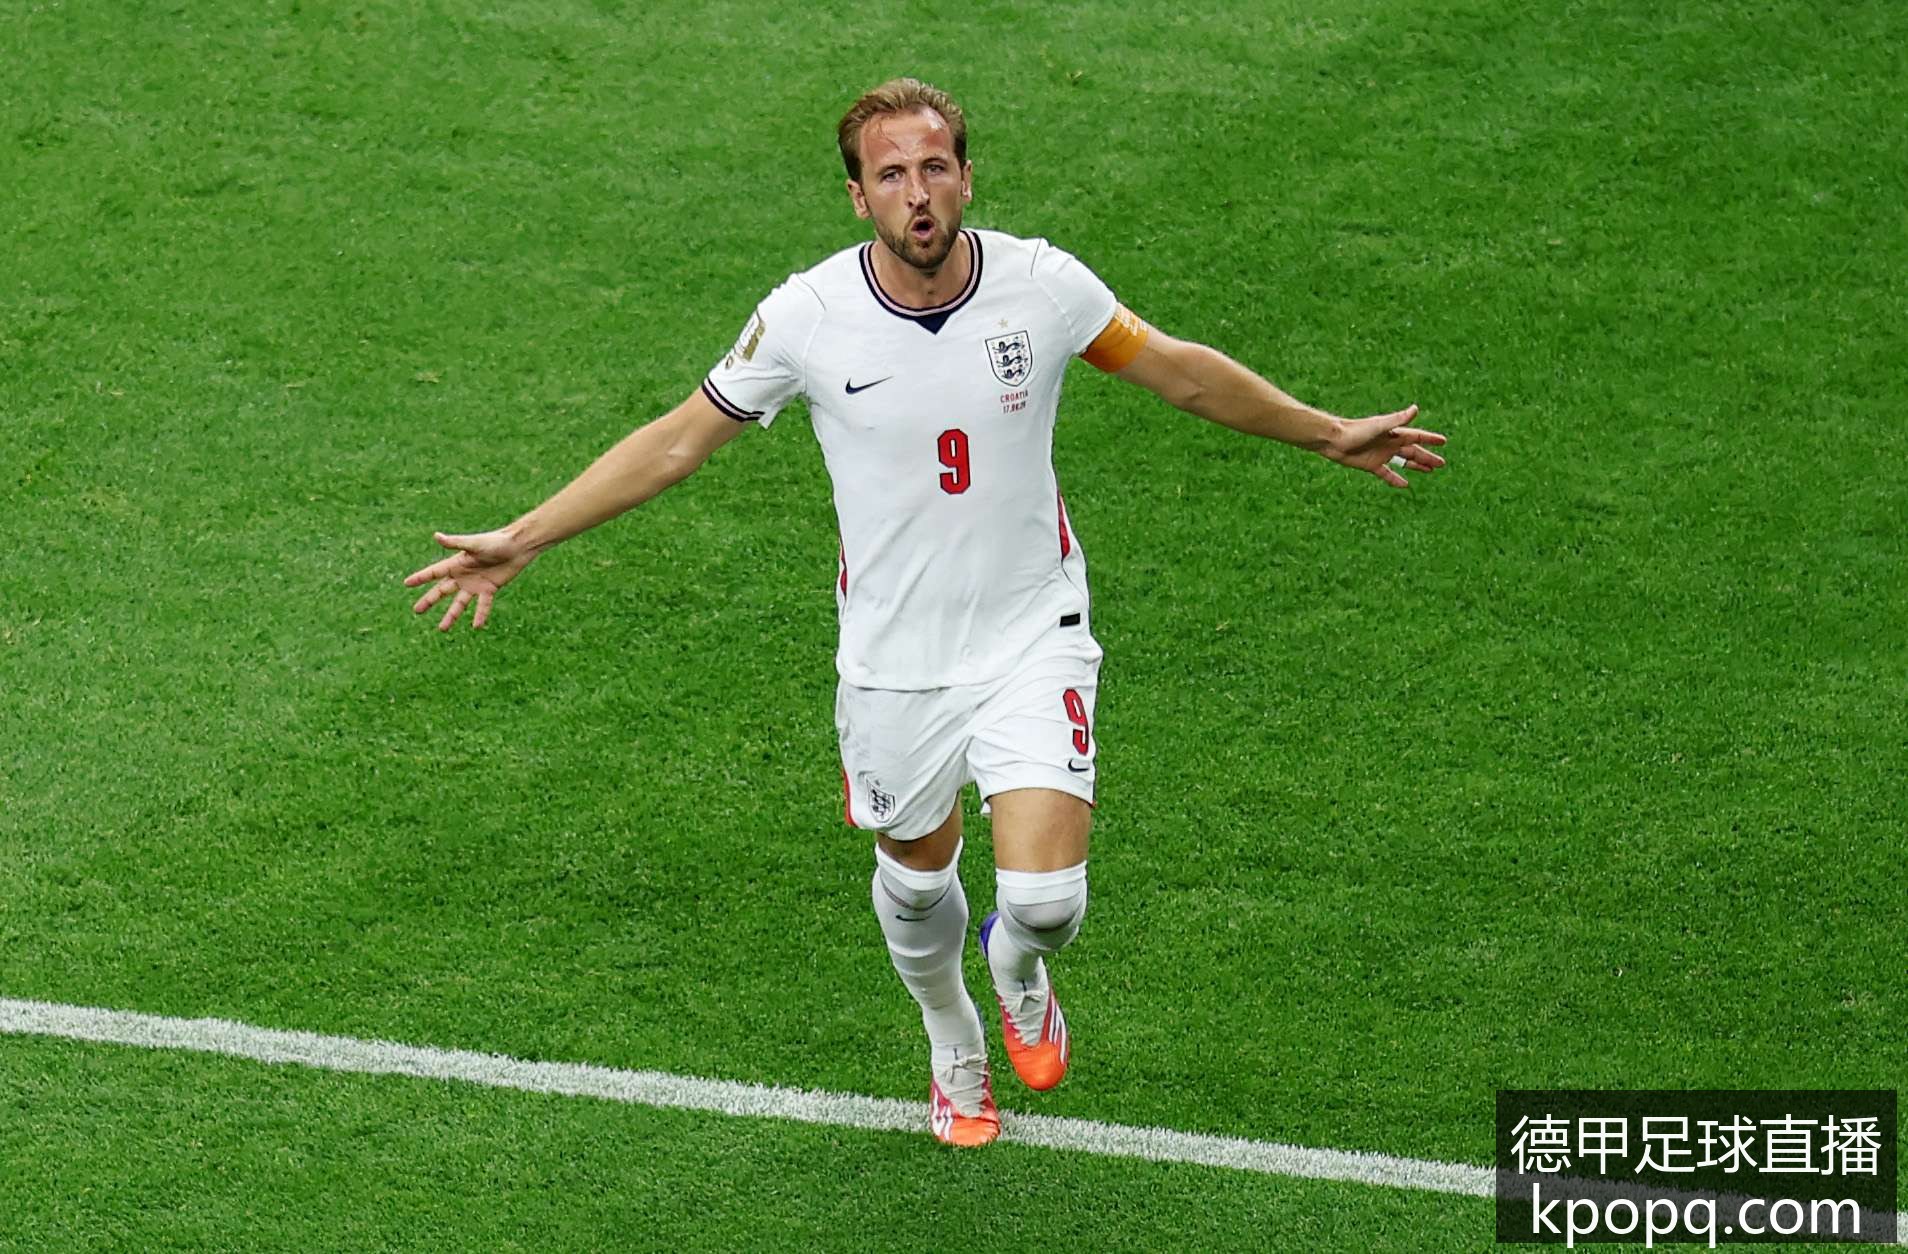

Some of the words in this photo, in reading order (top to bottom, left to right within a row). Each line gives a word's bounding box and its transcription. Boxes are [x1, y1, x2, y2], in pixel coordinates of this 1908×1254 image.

[1000, 389, 1028, 403] CROATIA
[938, 429, 970, 495] 9
[1063, 689, 1089, 756] 9
